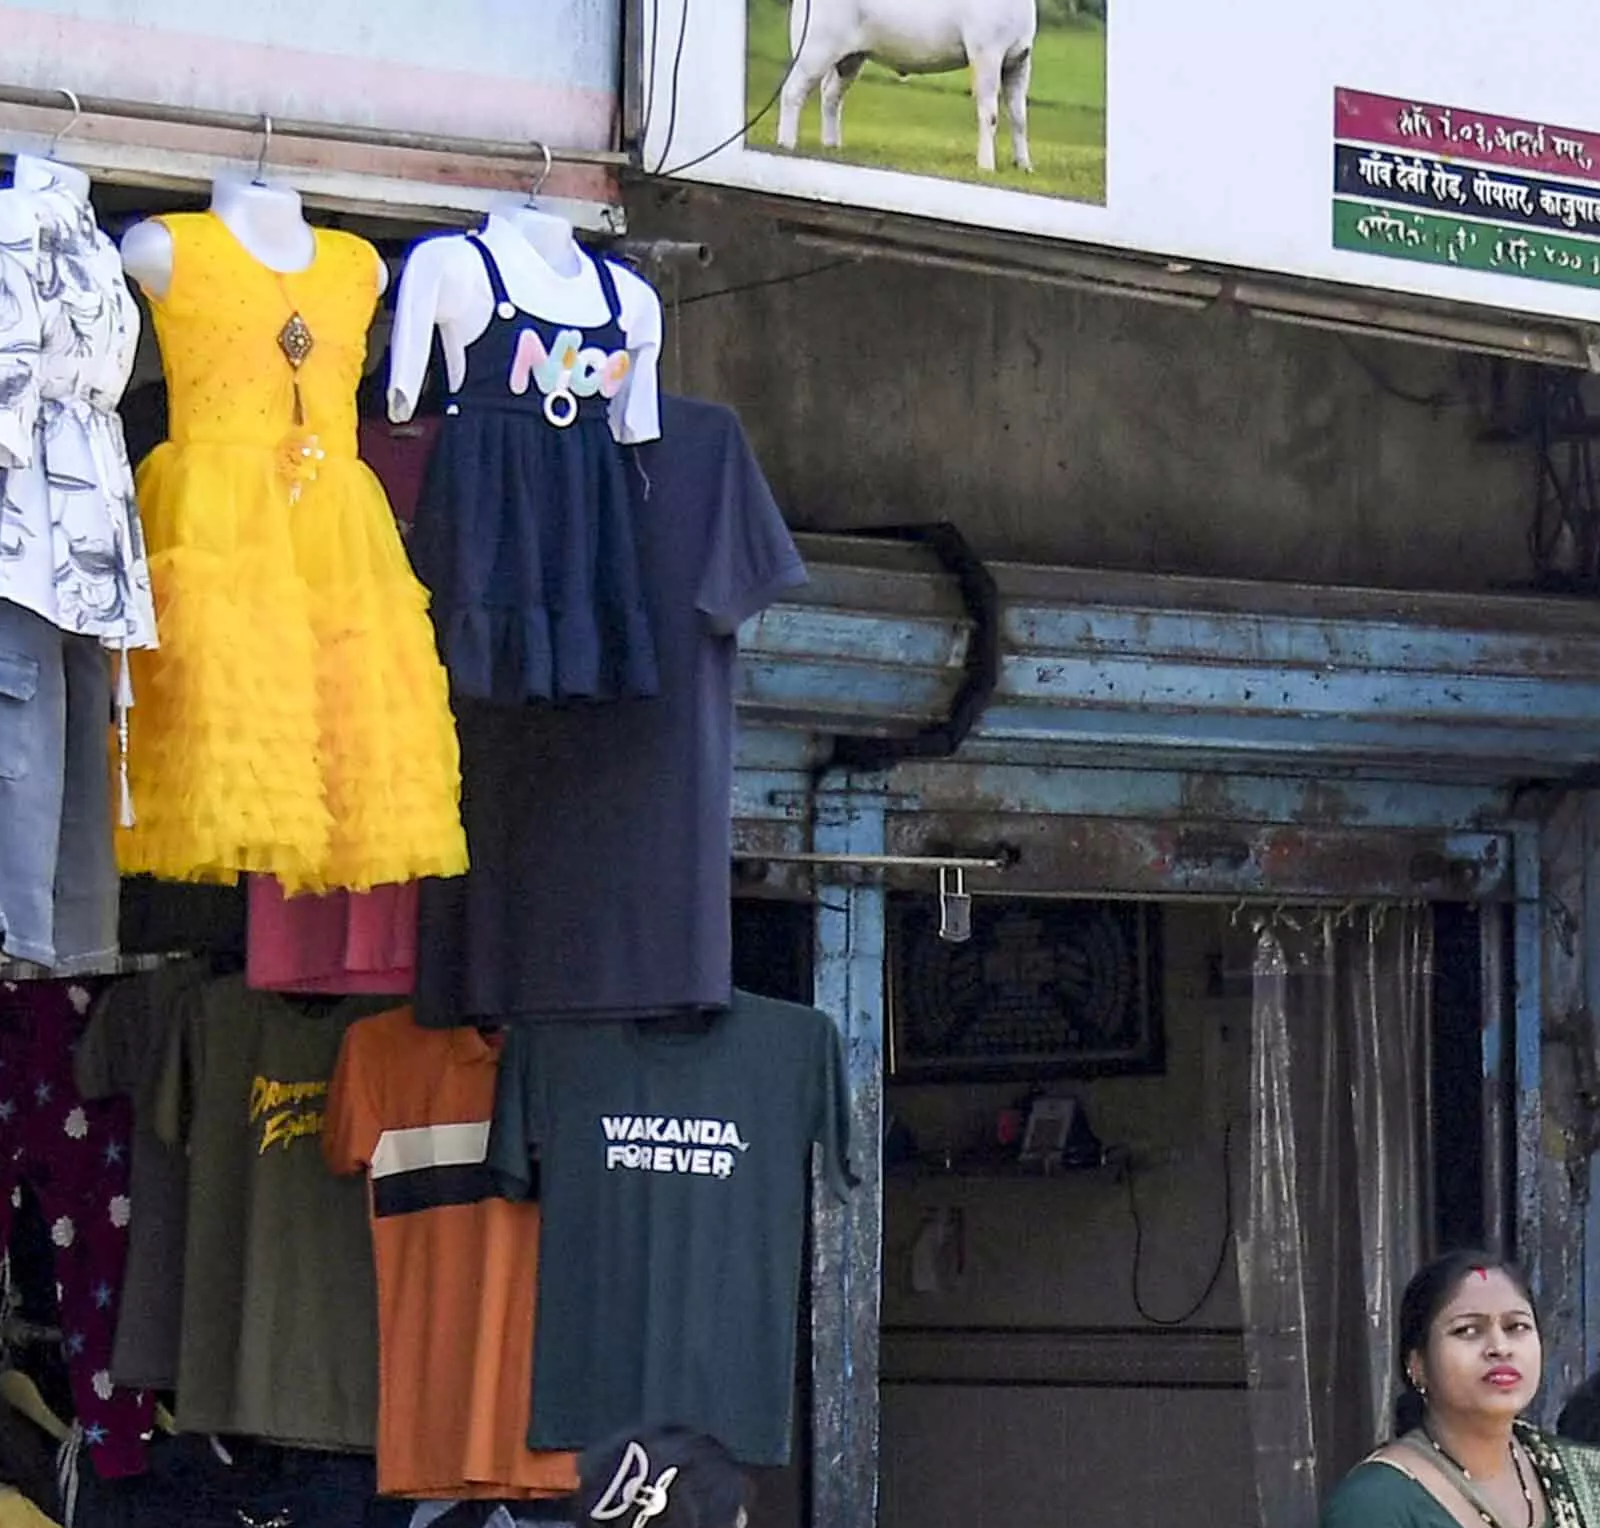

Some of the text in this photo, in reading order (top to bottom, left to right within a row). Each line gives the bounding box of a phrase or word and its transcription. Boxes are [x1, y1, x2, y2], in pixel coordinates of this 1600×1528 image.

[1394, 157, 1429, 195] देवी
[600, 1115, 742, 1147] WAKANDA
[606, 1143, 735, 1178] FOREVER
